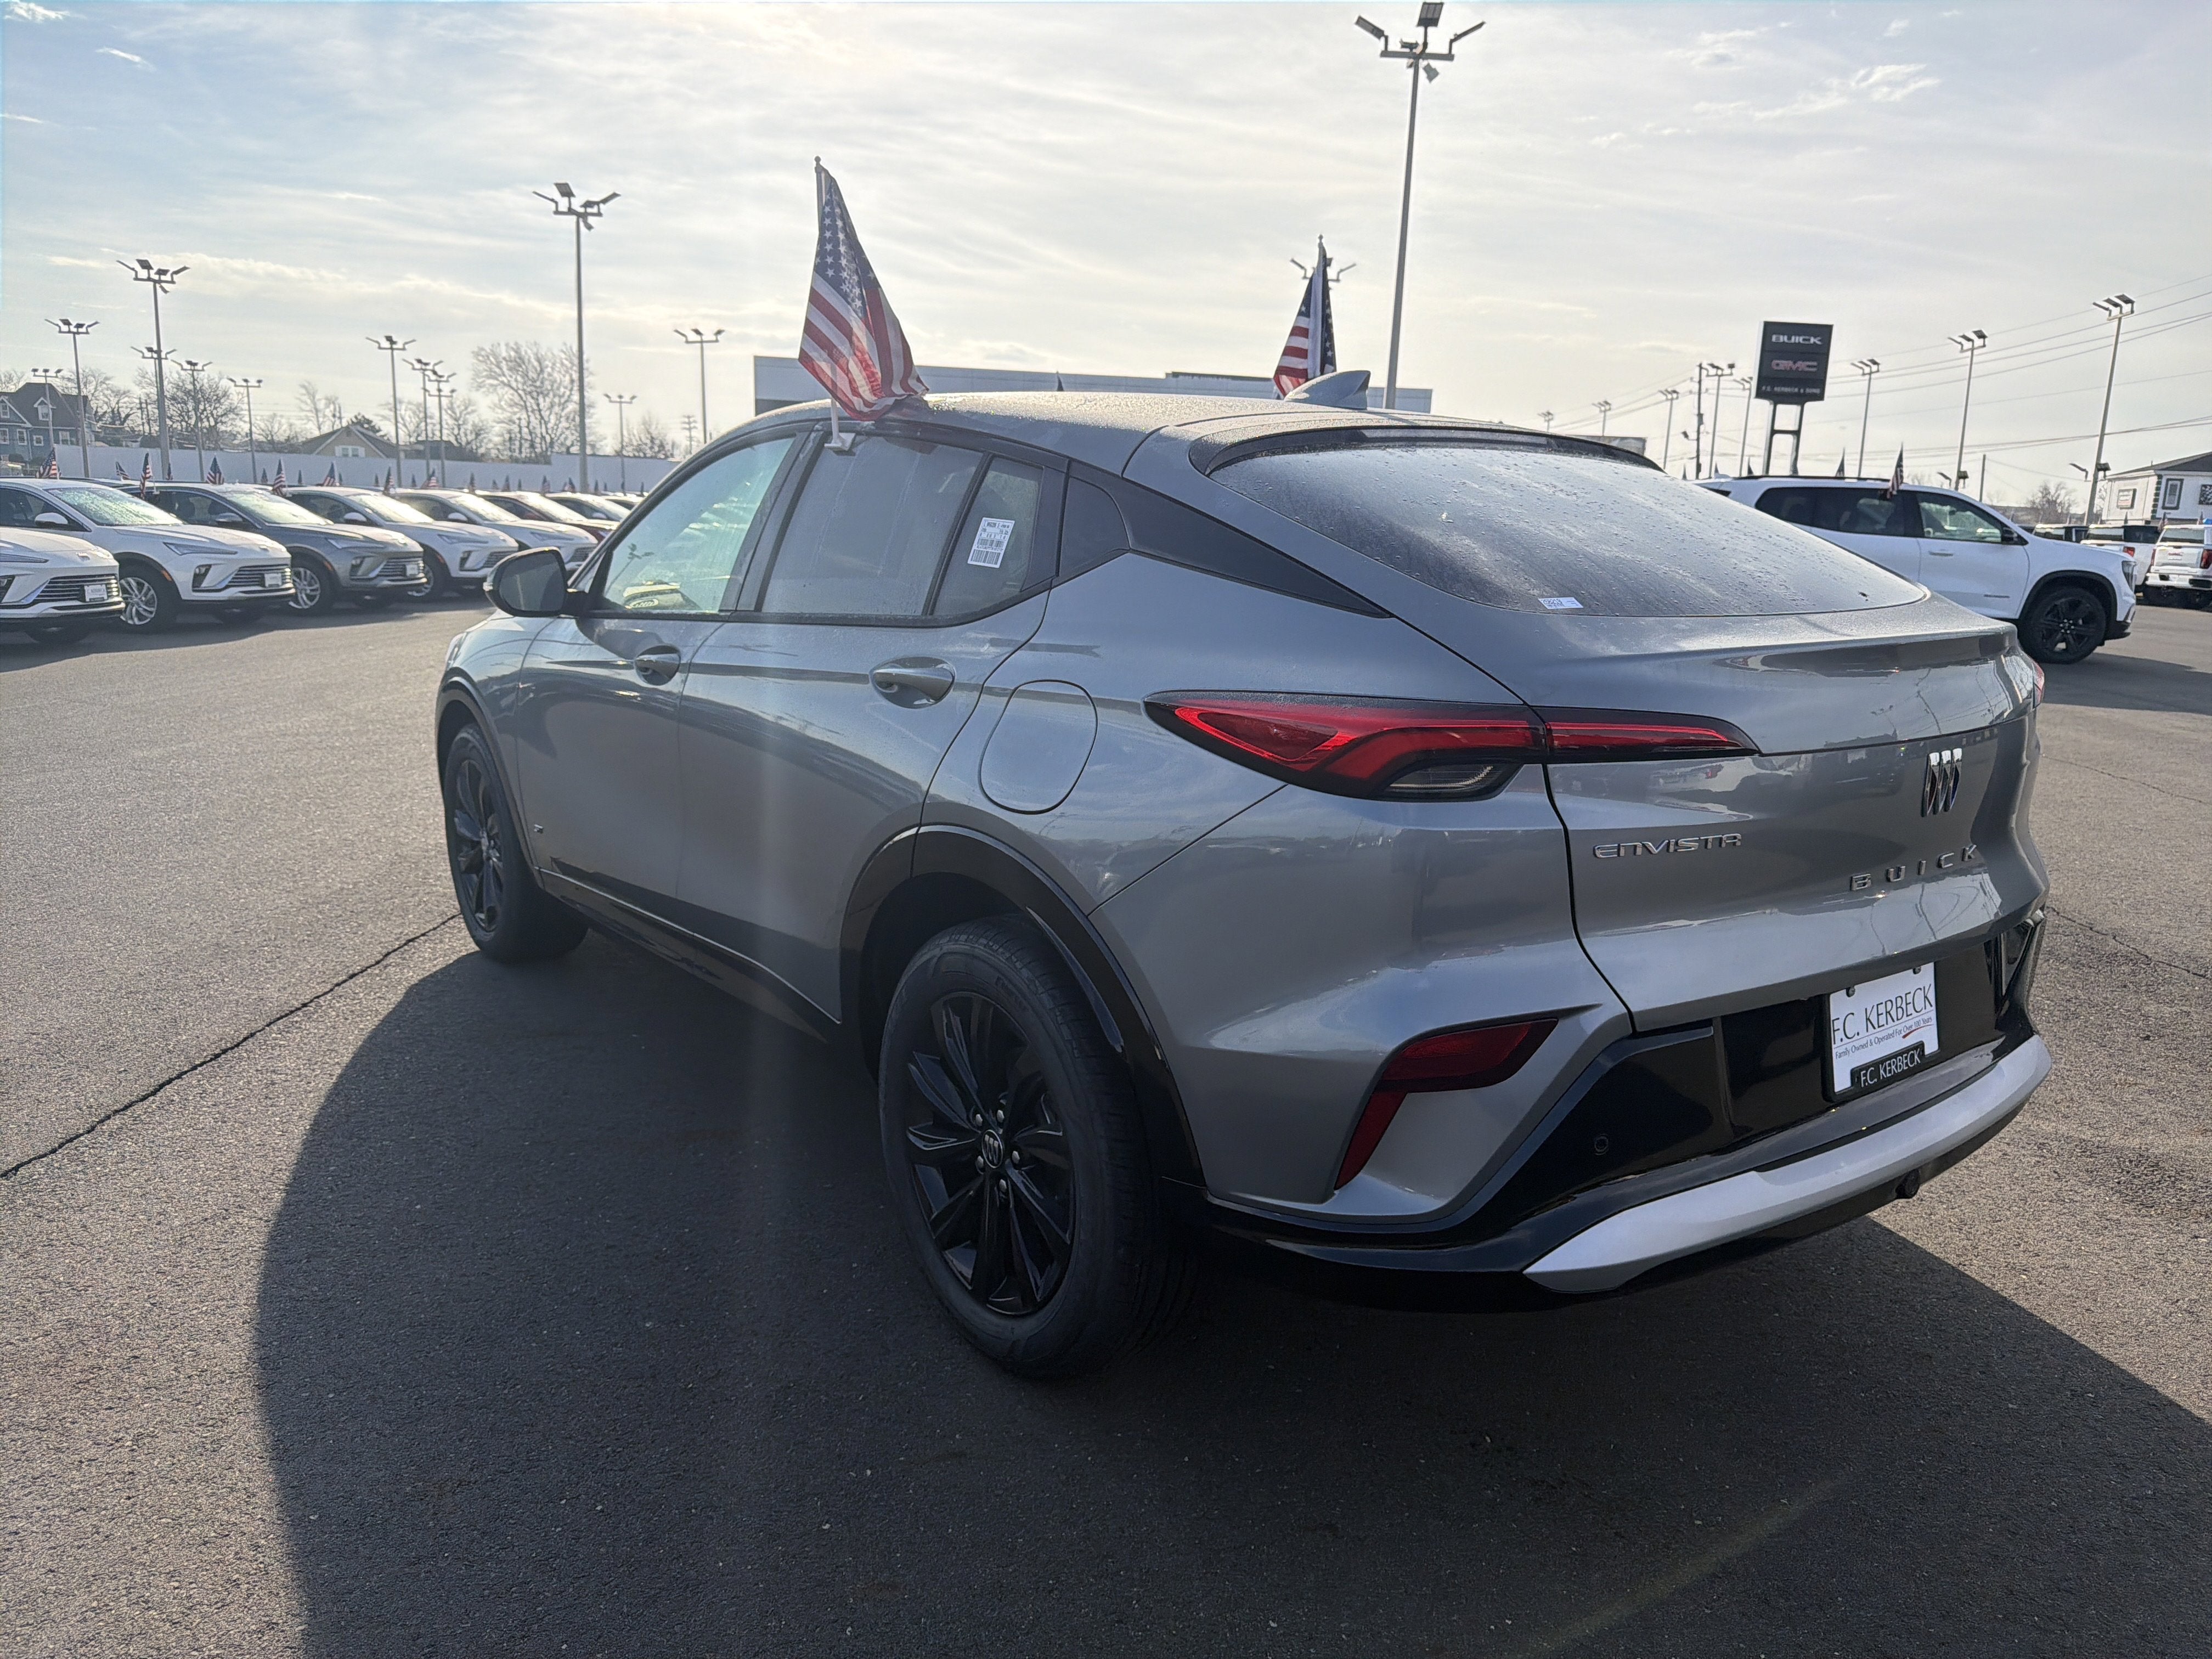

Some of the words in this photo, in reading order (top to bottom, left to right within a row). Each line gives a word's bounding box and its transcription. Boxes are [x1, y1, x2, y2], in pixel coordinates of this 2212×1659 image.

[1771, 334, 1822, 345] BUICK
[1771, 359, 1818, 372] GMC
[1594, 833, 1741, 858] ENVISTA
[1850, 844, 1977, 891] BUICK
[1832, 1012, 1860, 1045] F.C.
[1865, 984, 1933, 1032] KERBECK
[1835, 1047, 1850, 1059] Family
[1851, 1040, 1869, 1053] Owned
[1874, 1030, 1895, 1045] Operated
[1921, 1017, 1932, 1025] Years
[1860, 1068, 1877, 1087] F.C.
[1880, 1048, 1921, 1080] KERBECK
